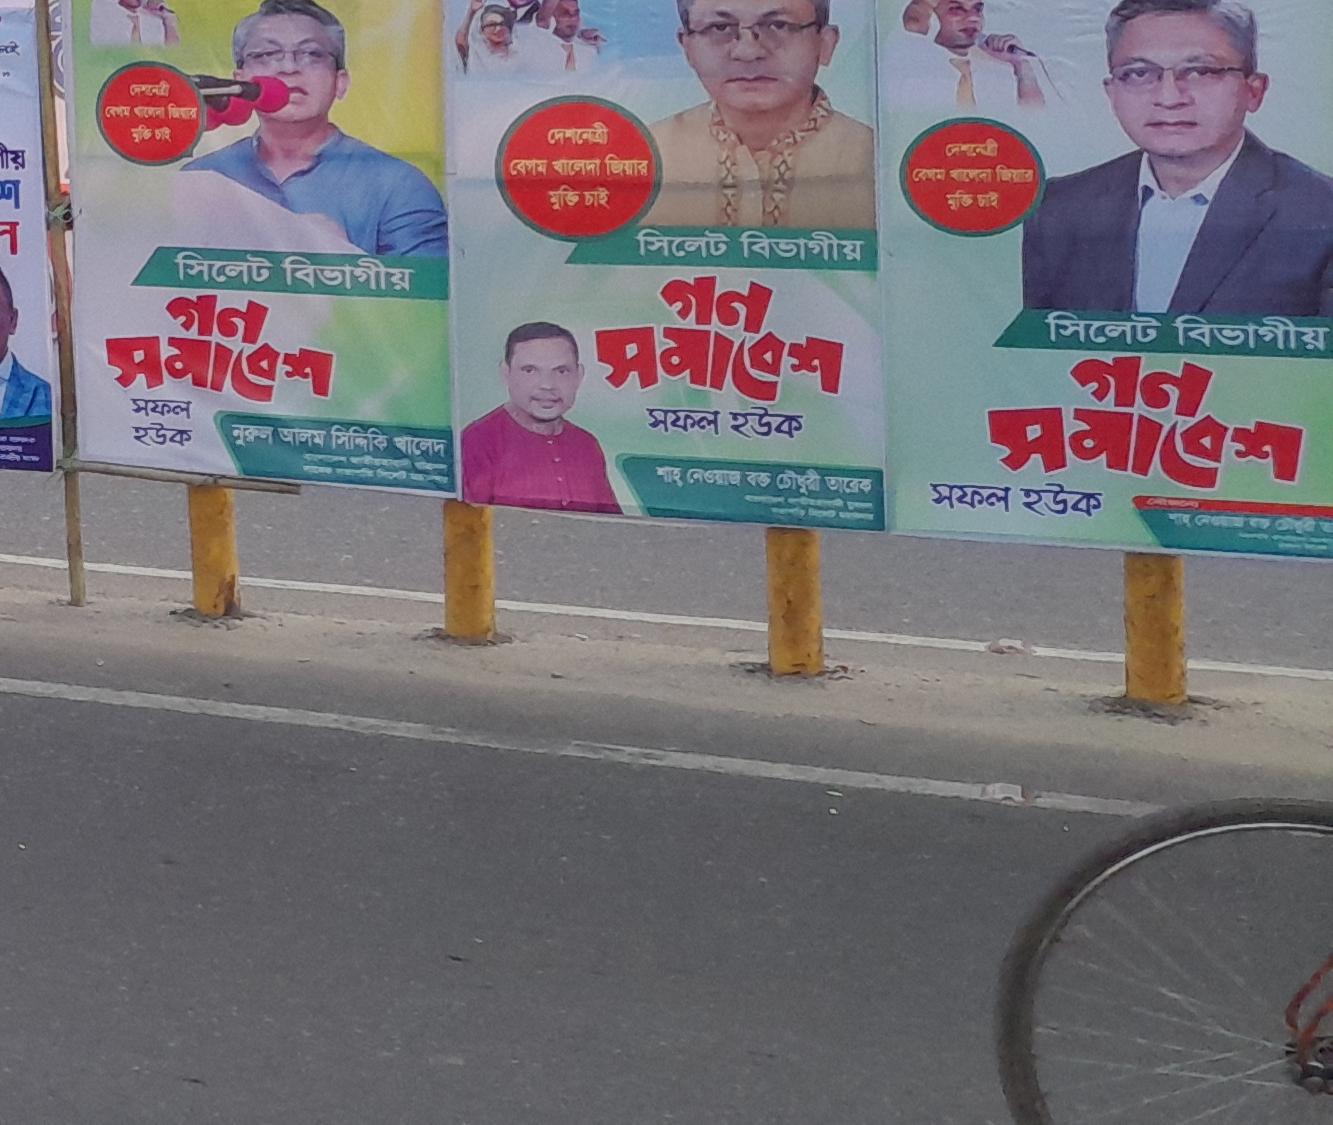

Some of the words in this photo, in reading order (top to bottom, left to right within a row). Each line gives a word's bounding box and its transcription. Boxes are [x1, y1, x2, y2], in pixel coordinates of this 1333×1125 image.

[548, 122, 610, 146] দেশনেত্রী
[510, 159, 546, 177] বেগম
[552, 159, 600, 177] খালেদা
[606, 154, 649, 177] জিয়ার
[549, 186, 579, 211] মুক্তি
[583, 186, 610, 210] চাই
[636, 229, 730, 258] সিলেট
[741, 231, 865, 262] বিভাগীয়
[175, 252, 273, 284] সিলেট
[281, 258, 414, 291] বিভাগীয়
[165, 294, 269, 345] গণ
[660, 275, 773, 335] গণ
[1045, 311, 1161, 346] সিলেট
[1174, 315, 1331, 351] বিভাগীয়
[105, 336, 334, 403] সমাবেশ
[595, 326, 844, 402] সমাবেশ
[1071, 355, 1214, 418] গণ
[131, 398, 192, 419] সফল
[646, 407, 719, 435] সফল
[729, 407, 803, 438] হউক
[132, 423, 192, 447] হউক
[987, 407, 1305, 488] সমাবেশ
[930, 482, 1012, 512] সফল
[1020, 483, 1103, 517] হউক
